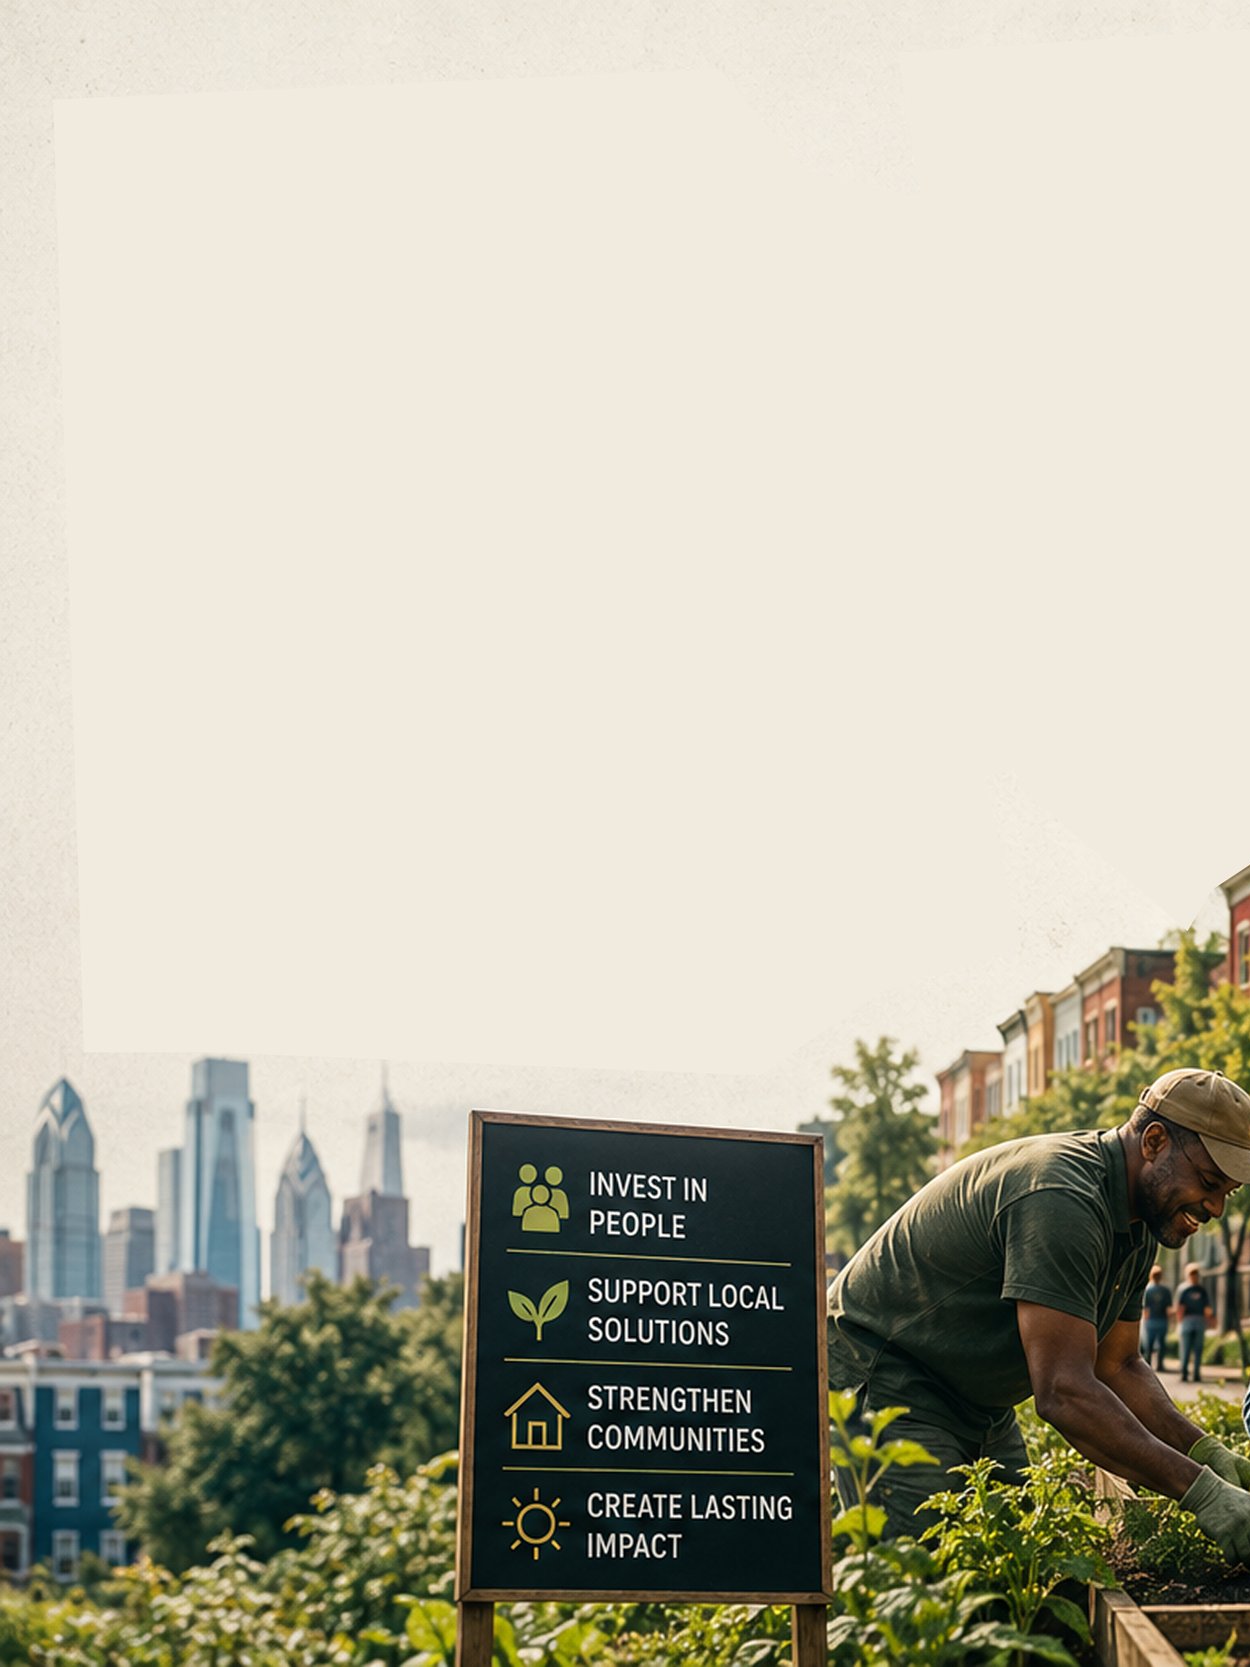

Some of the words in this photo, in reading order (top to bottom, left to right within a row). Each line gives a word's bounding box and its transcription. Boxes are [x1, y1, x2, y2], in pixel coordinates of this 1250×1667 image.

[591, 1172, 676, 1199] INVEST
[684, 1178, 706, 1201] IN
[591, 1210, 685, 1238] PEOPLE
[589, 1278, 701, 1306] SUPPORT
[709, 1284, 784, 1310] LOCAL
[589, 1317, 729, 1345] SOLUTIONS
[588, 1385, 750, 1413] STRENGTHEN
[588, 1425, 764, 1452] COMMUNITIES
[588, 1493, 682, 1518] CREATE
[692, 1495, 792, 1520] LASTING
[589, 1533, 682, 1558] IMPACT
